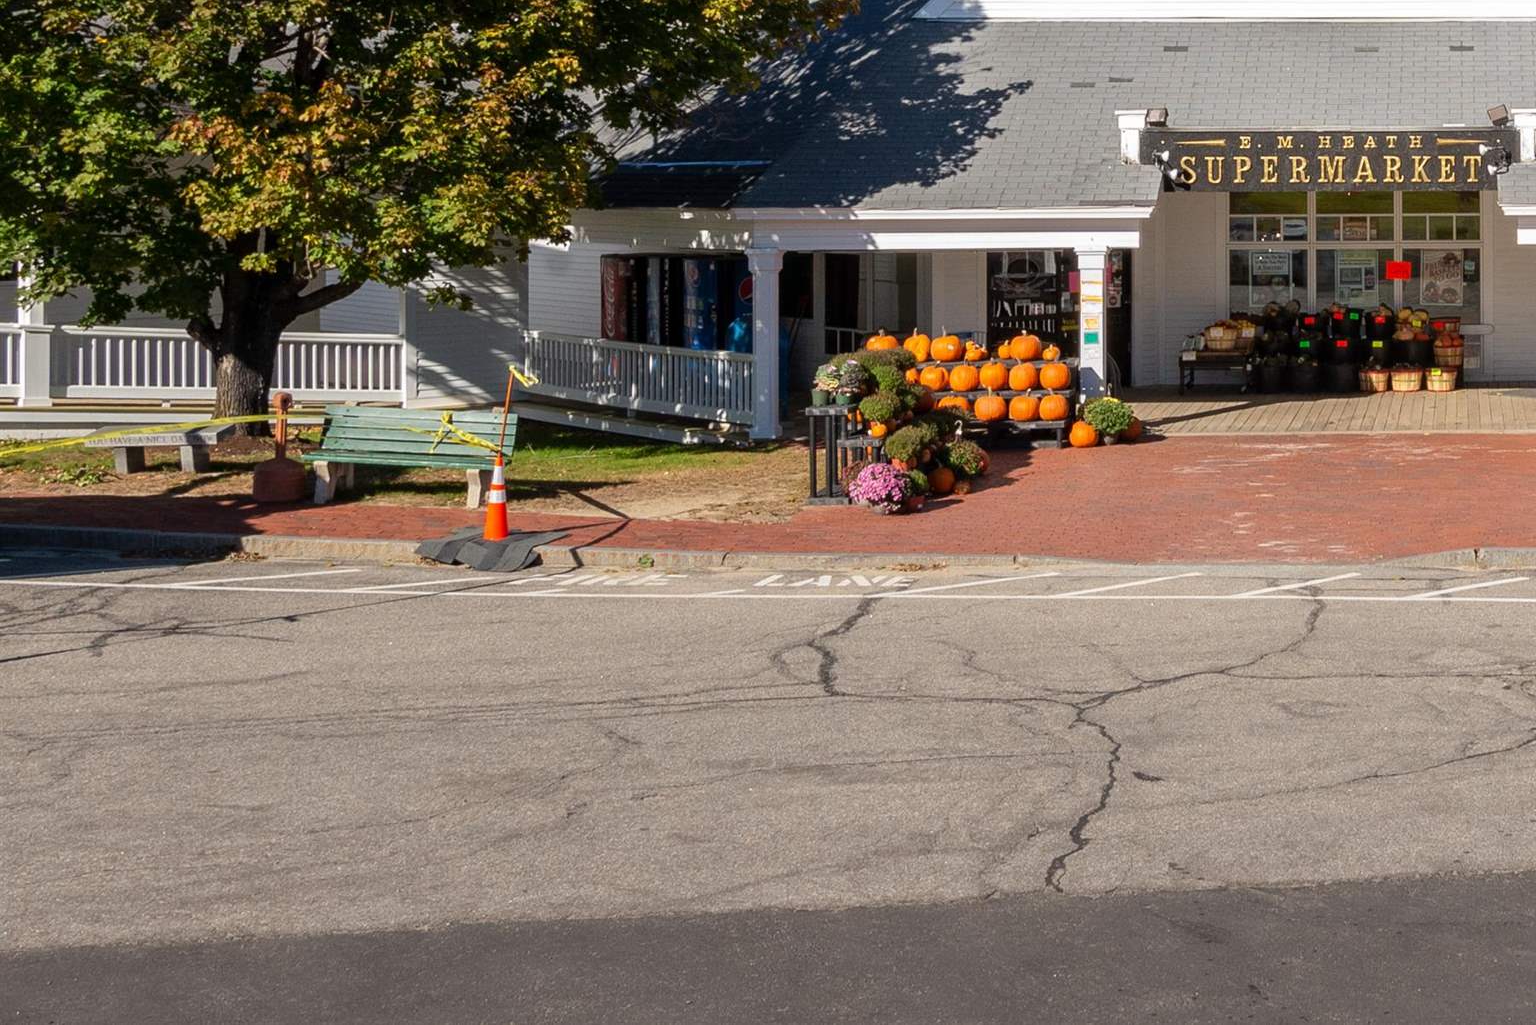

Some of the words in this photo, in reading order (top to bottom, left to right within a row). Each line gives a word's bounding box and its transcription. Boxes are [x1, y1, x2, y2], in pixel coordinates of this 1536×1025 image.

[1239, 135, 1262, 149] E.
[1277, 135, 1304, 149] M.
[1318, 135, 1423, 149] HEATH
[1180, 155, 1482, 184] SUPERMARKET
[752, 574, 919, 587] LANE
